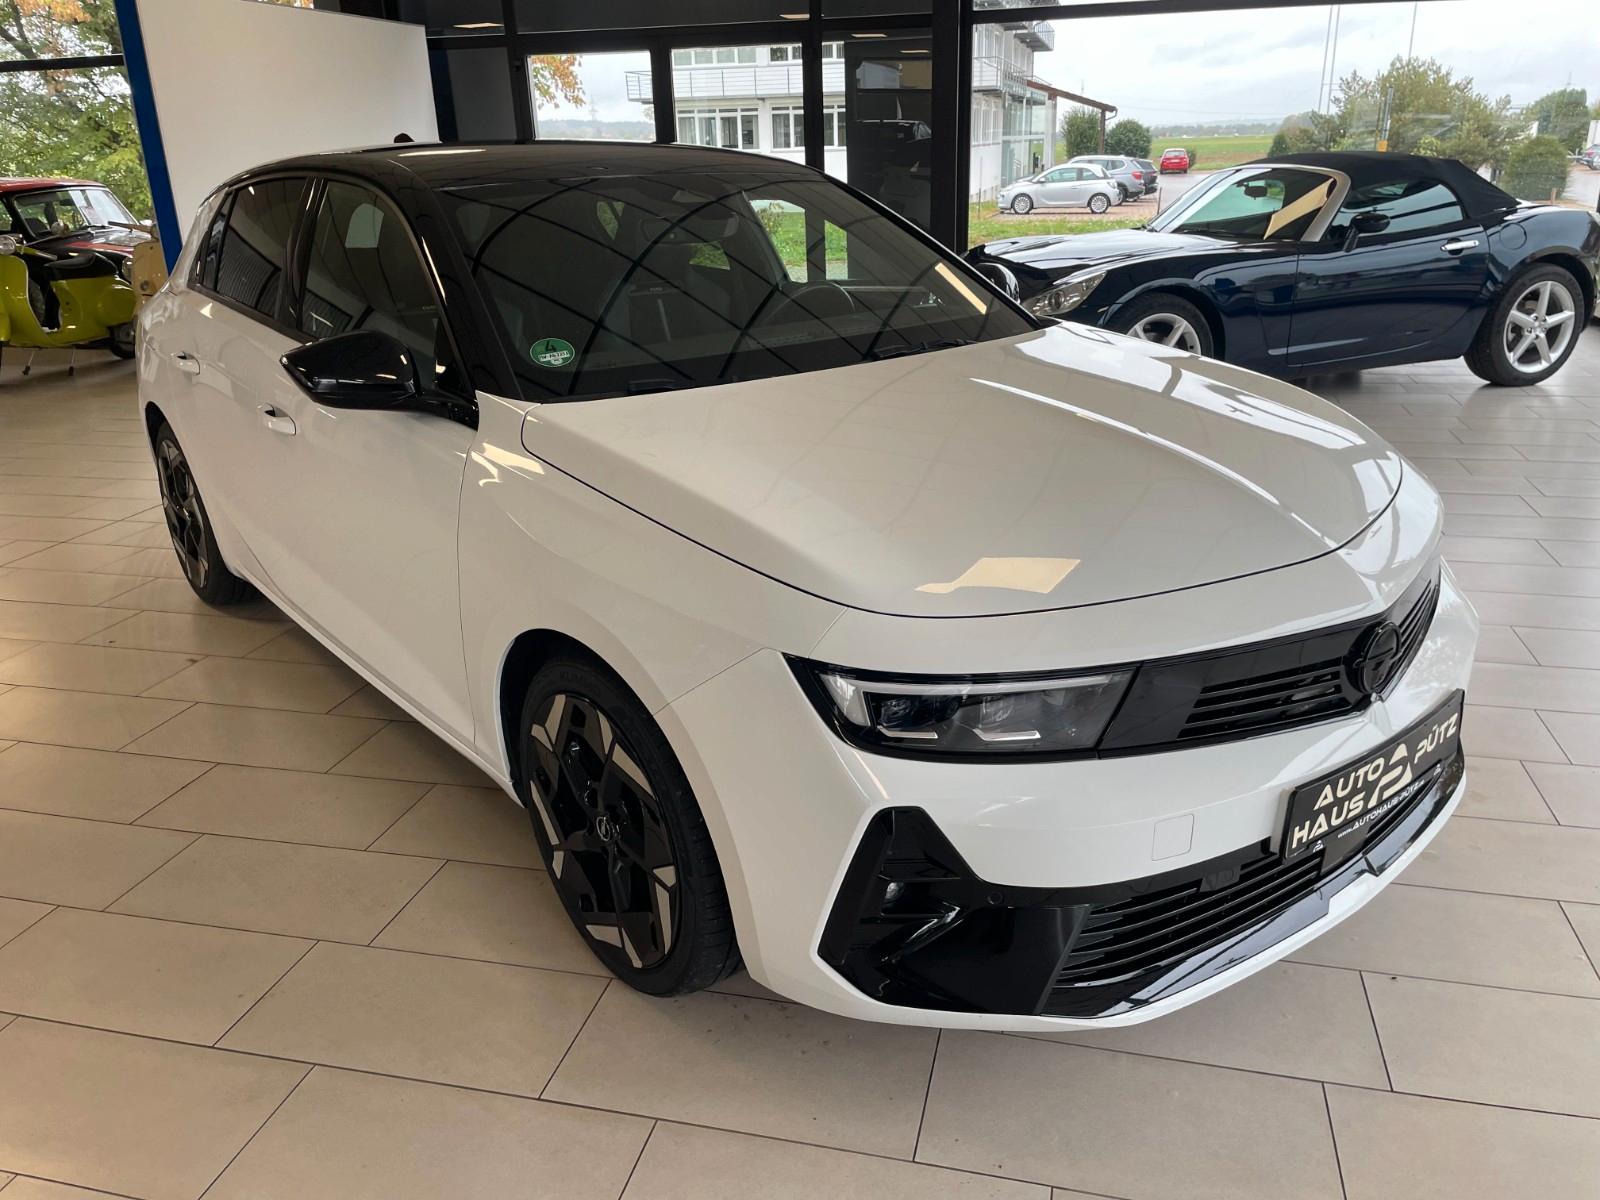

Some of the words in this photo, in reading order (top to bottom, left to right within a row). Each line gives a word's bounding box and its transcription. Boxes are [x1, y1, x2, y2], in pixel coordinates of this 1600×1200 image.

[1414, 712, 1458, 764] PÜTZ
[1313, 757, 1384, 811] AUTO
[1292, 791, 1366, 849] HAUS
